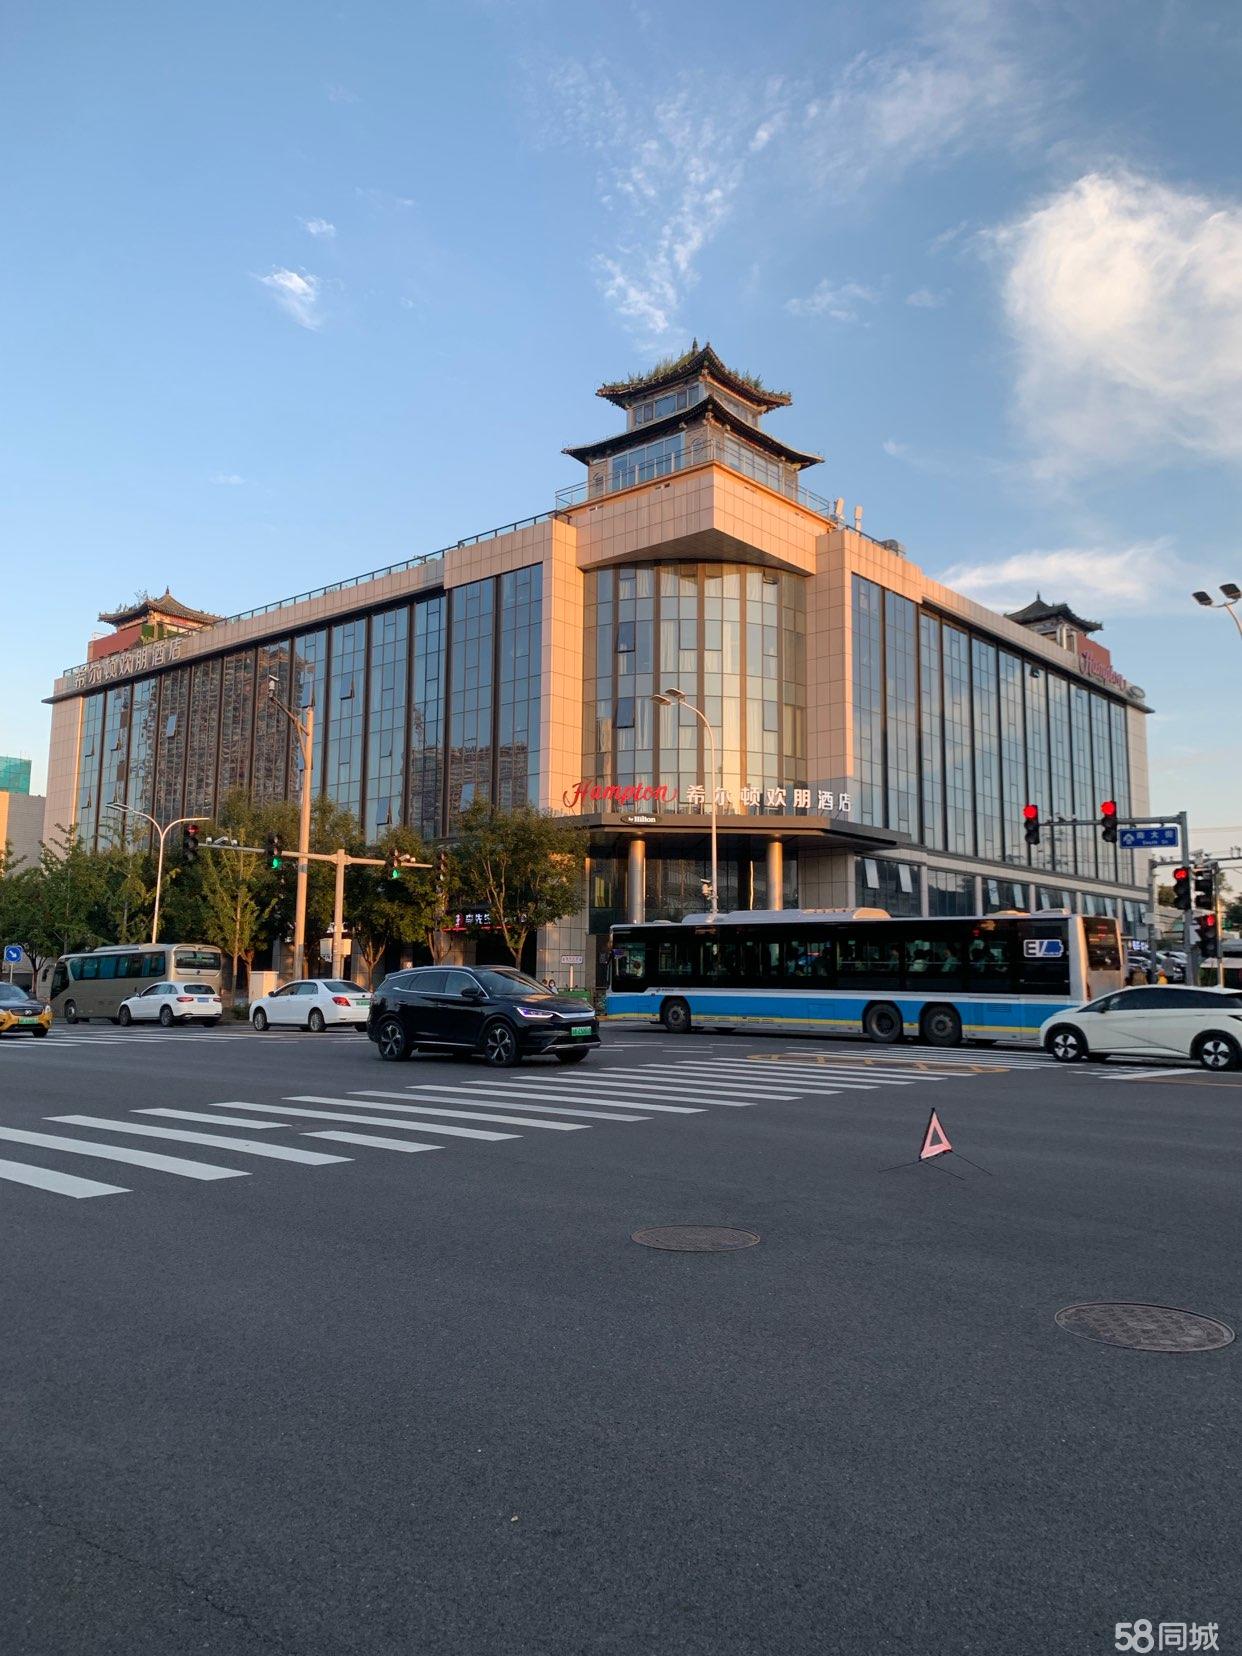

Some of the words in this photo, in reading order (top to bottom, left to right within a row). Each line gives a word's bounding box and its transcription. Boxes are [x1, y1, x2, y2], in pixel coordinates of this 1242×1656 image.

[562, 780, 678, 808] Hampton
[685, 784, 853, 812] 希尔顿欢朋酒店
[634, 815, 656, 823] Hilton
